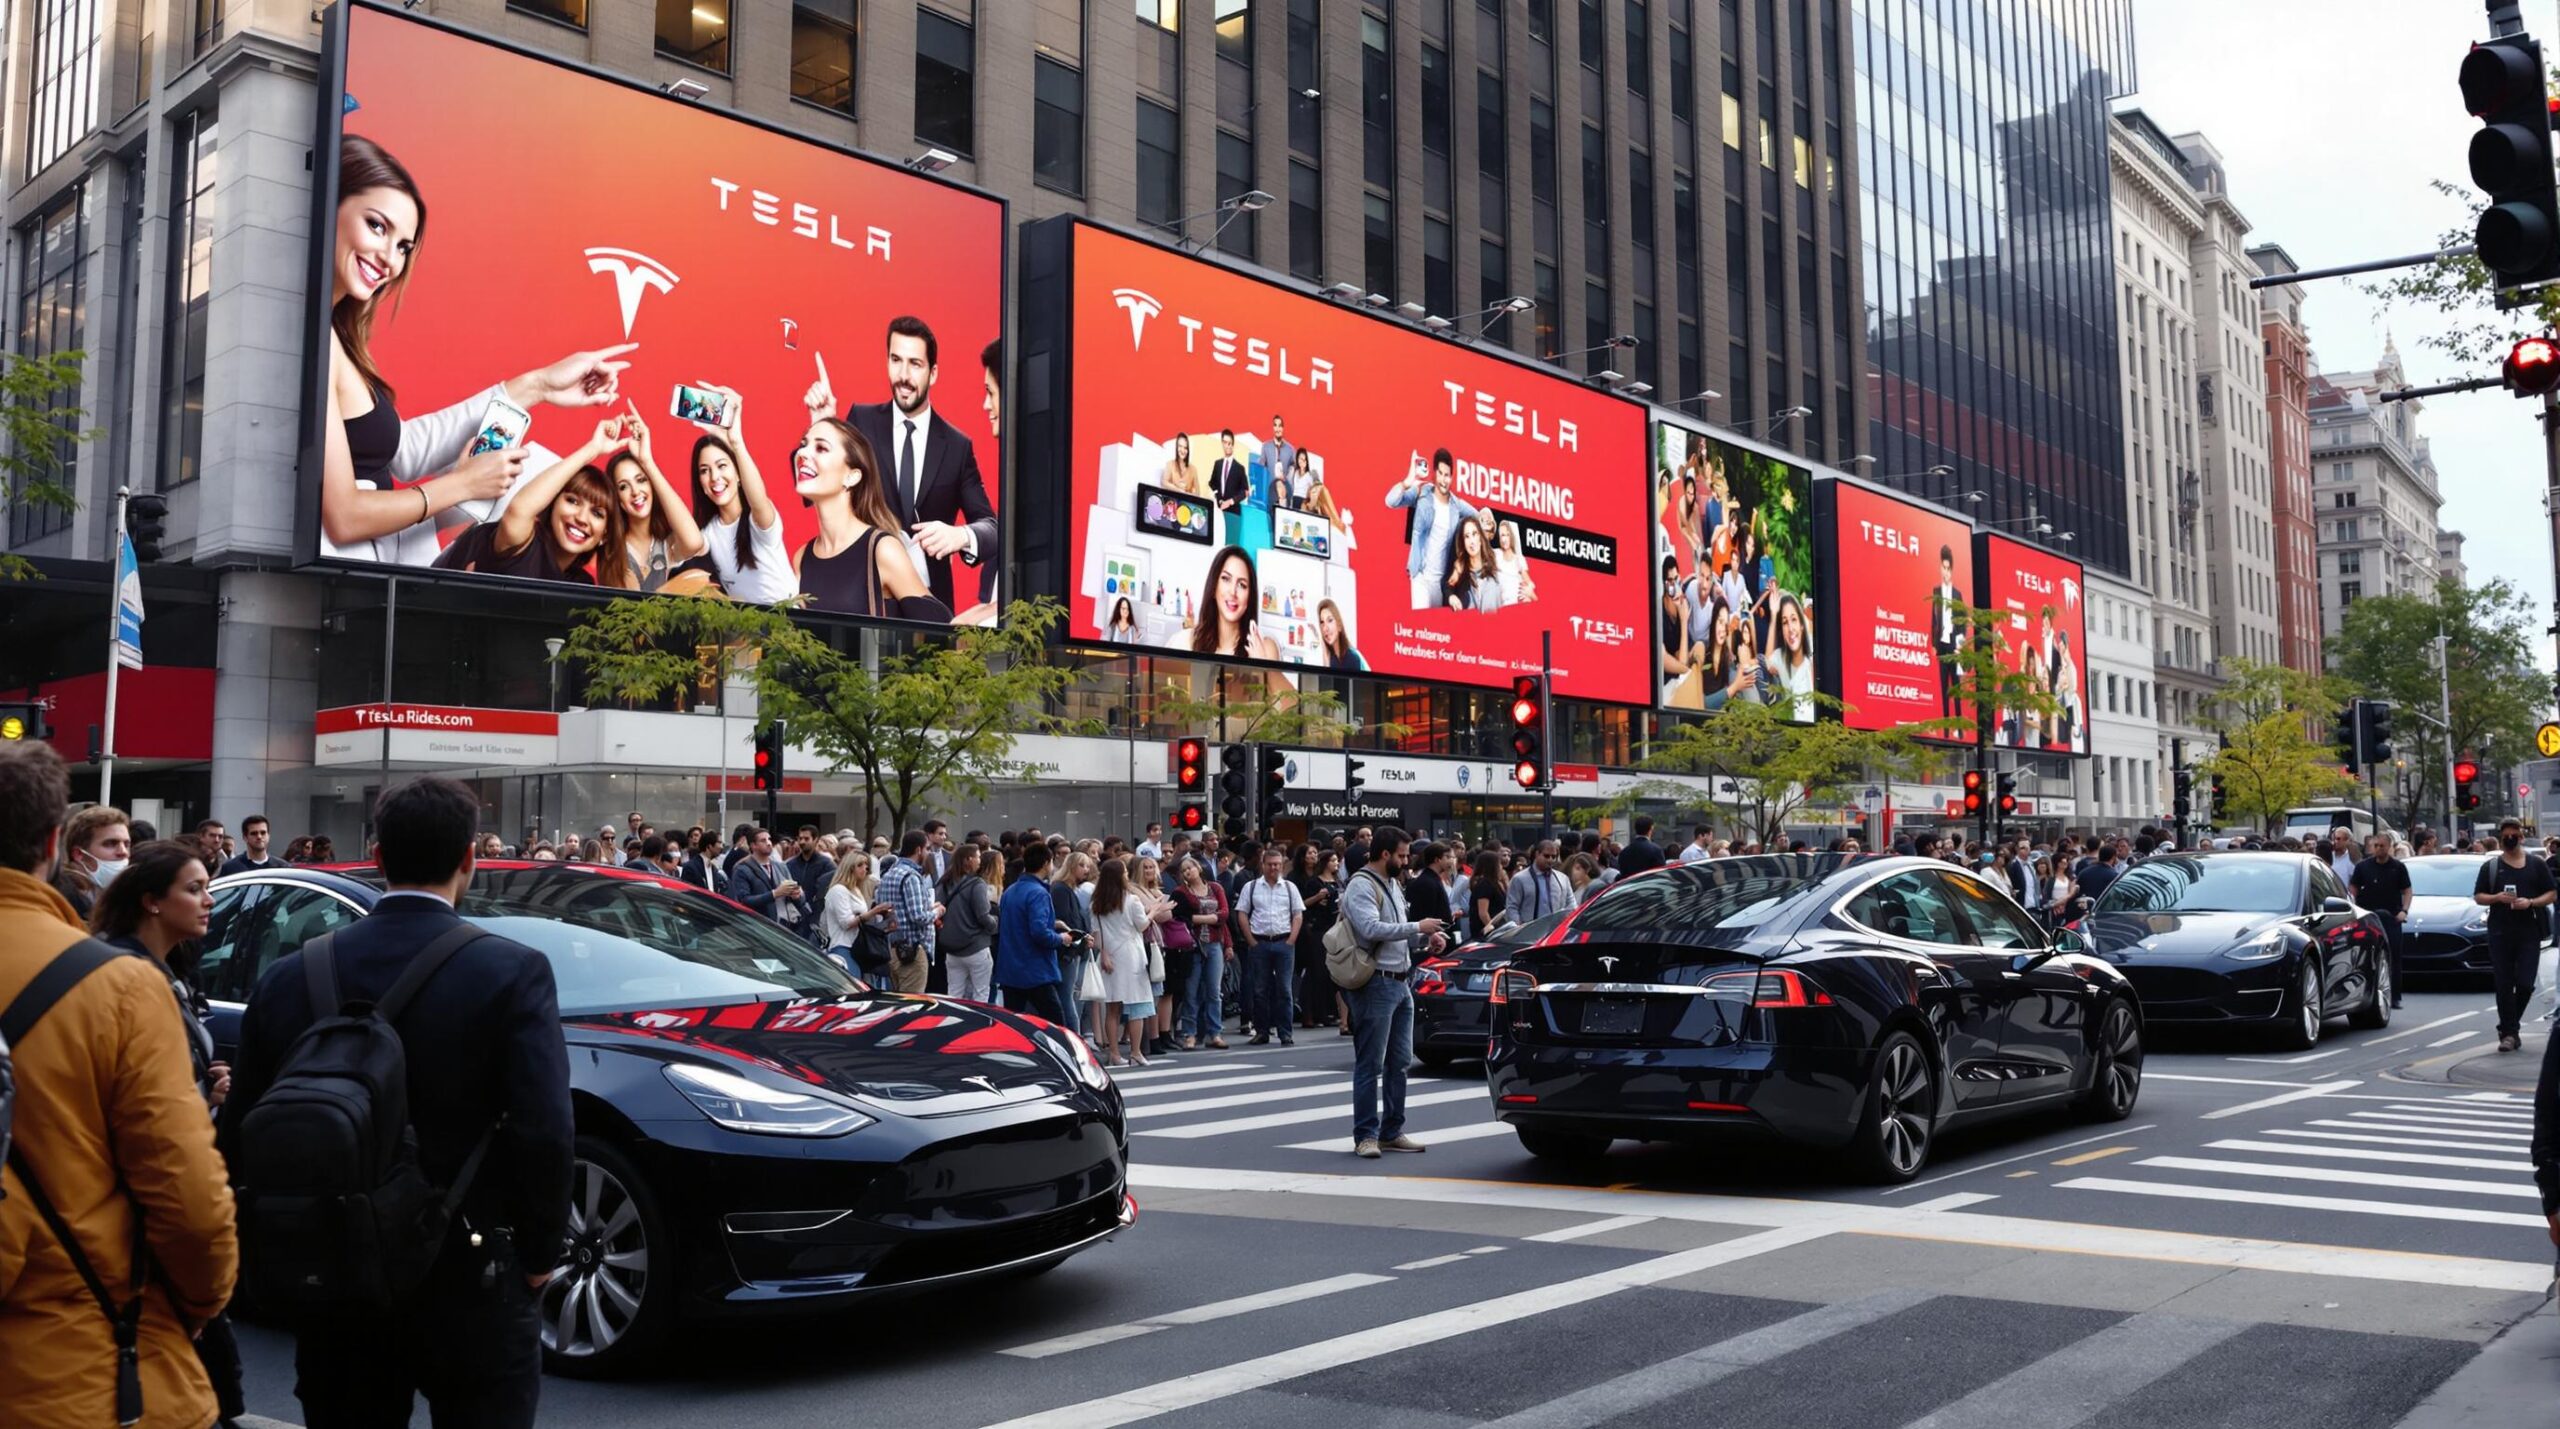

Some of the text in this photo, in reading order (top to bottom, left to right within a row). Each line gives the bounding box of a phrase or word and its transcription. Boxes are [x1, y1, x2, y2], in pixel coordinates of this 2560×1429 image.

[711, 177, 893, 262] TESLA
[1178, 316, 1333, 395] TESLA
[1443, 380, 1579, 453] TESLA
[1456, 458, 1575, 521] RIDEHARING
[1860, 519, 1920, 556] TESLA
[2015, 569, 2051, 595] TESLA
[1585, 619, 1635, 641] TESLA
